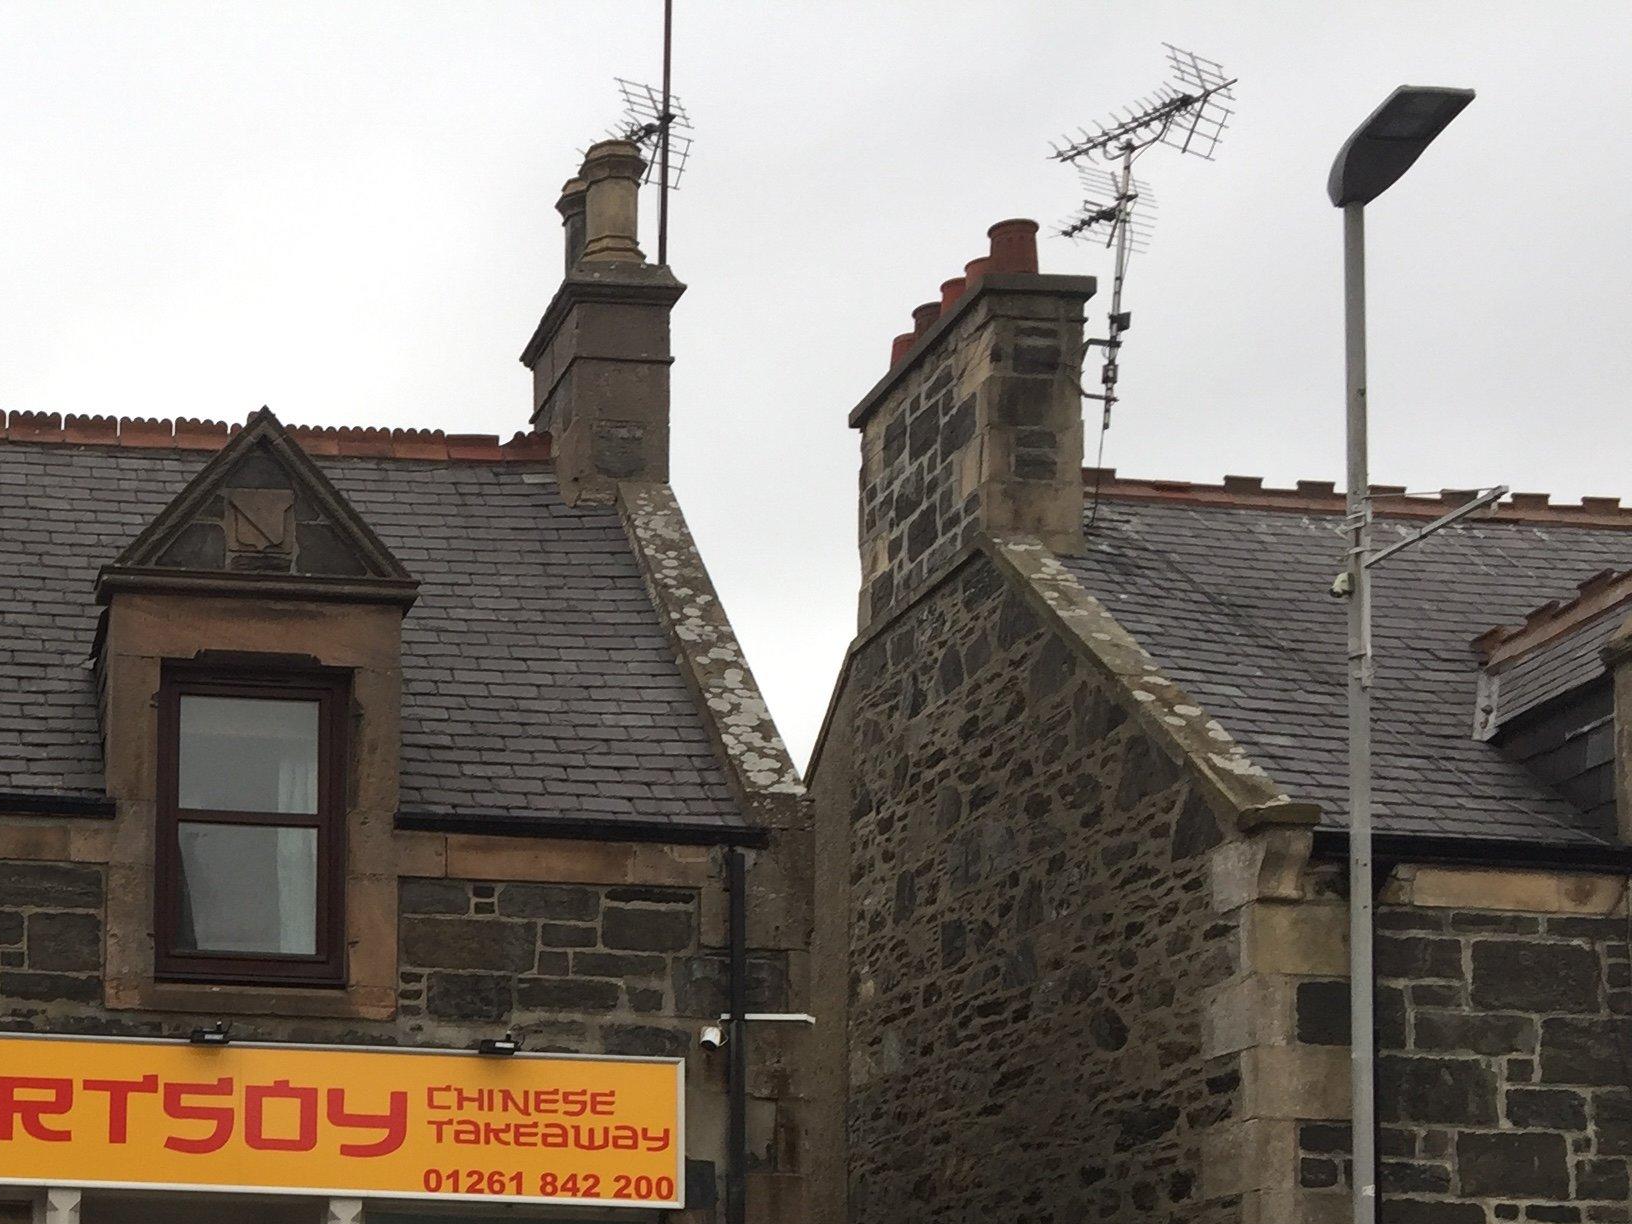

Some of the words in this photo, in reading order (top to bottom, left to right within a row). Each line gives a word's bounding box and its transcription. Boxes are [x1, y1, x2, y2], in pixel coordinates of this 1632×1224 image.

[426, 1084, 616, 1117] CHINESE
[422, 1168, 524, 1196] 01261
[539, 1172, 601, 1198] 842
[612, 1174, 674, 1200] 200
